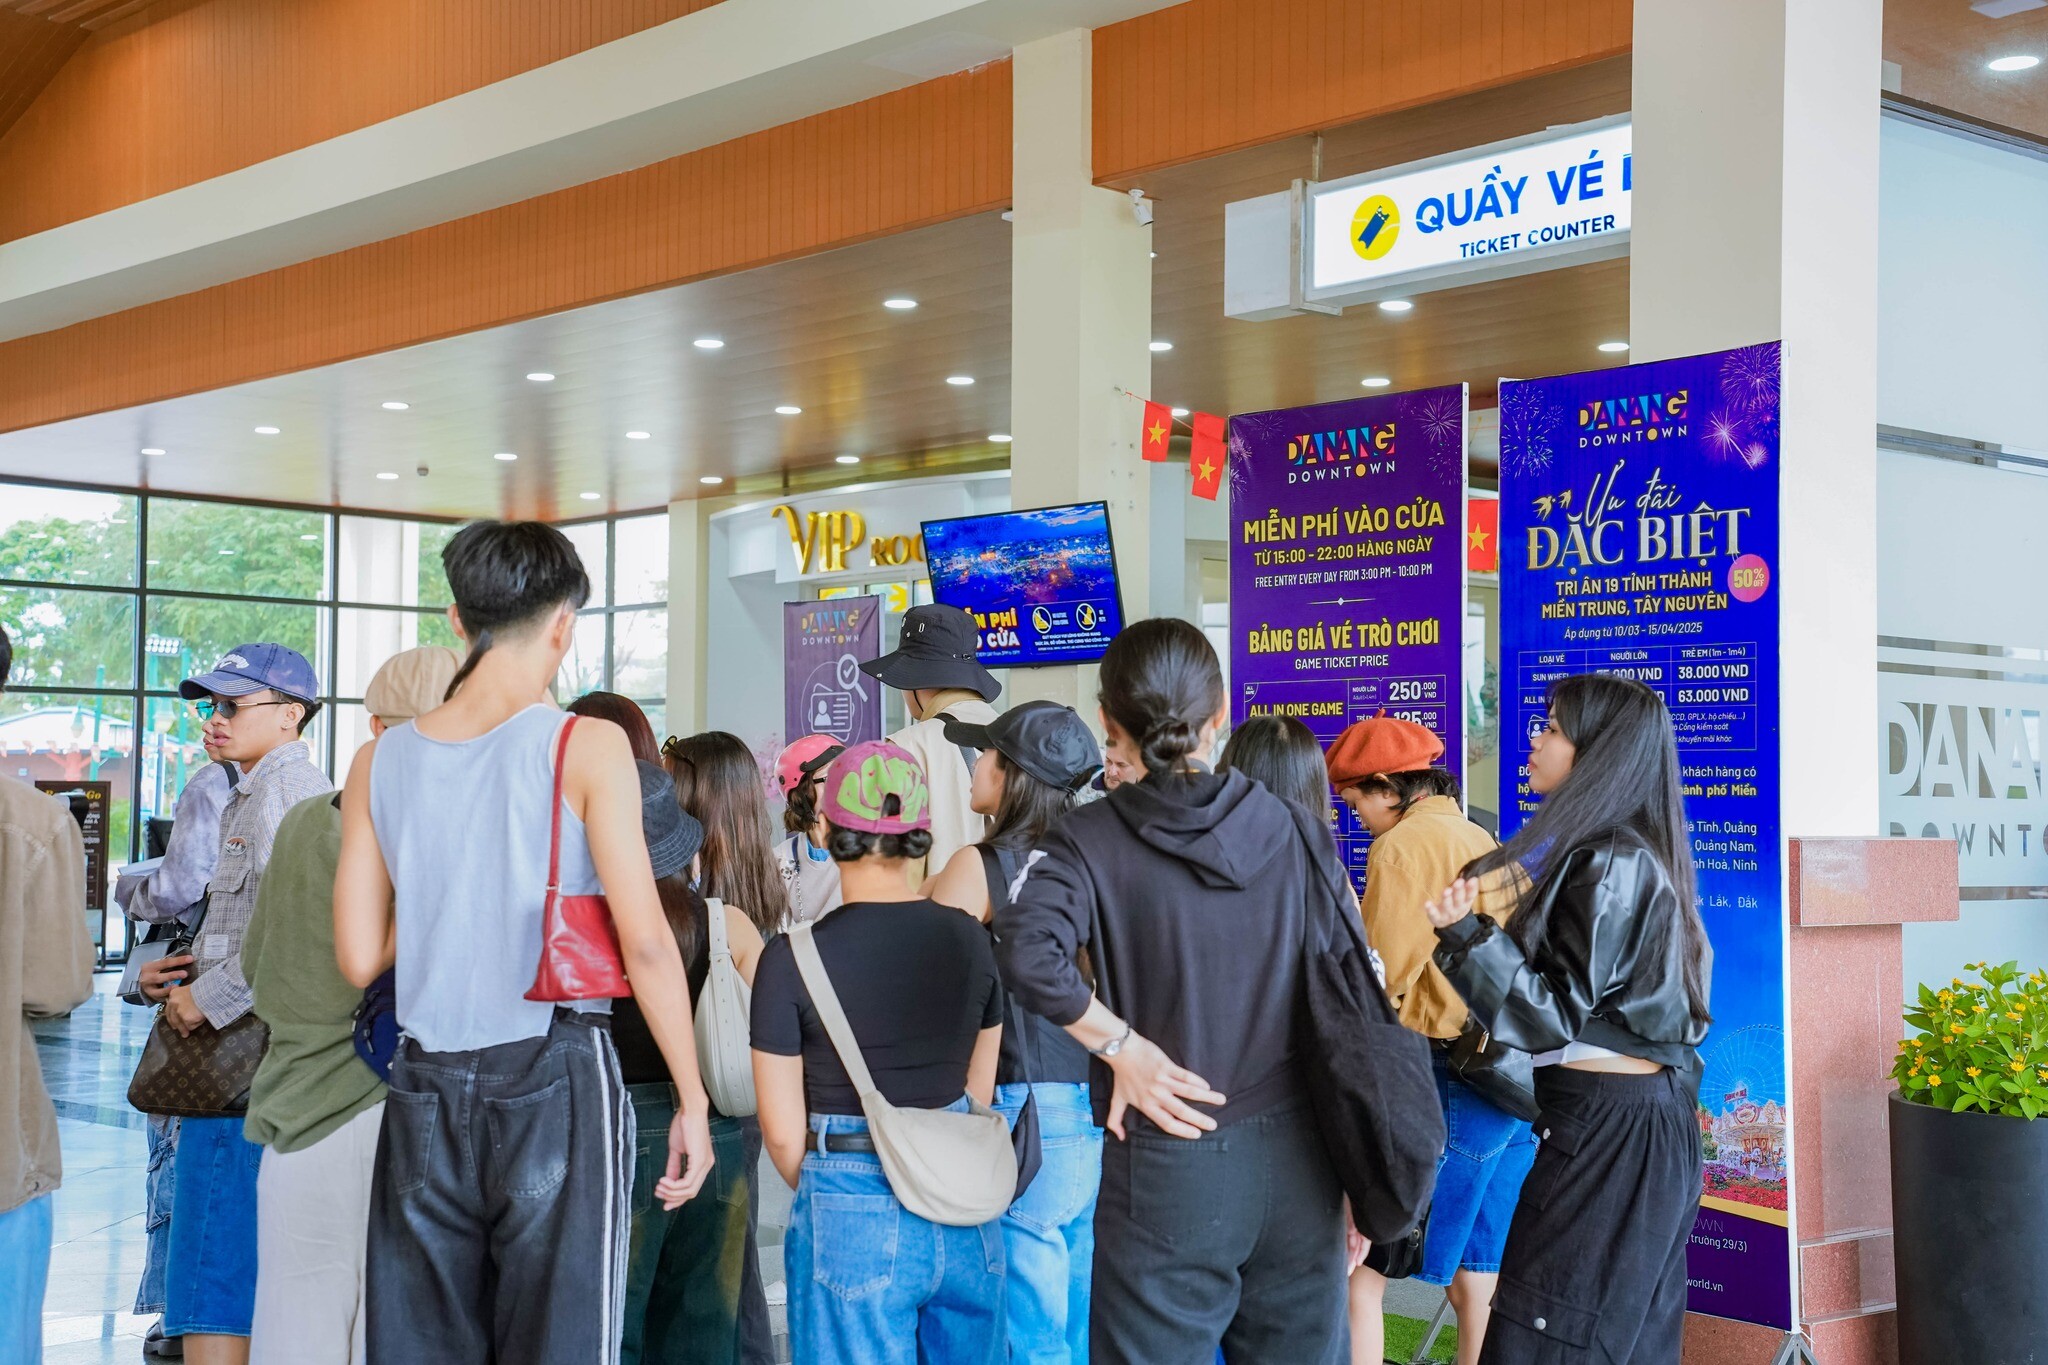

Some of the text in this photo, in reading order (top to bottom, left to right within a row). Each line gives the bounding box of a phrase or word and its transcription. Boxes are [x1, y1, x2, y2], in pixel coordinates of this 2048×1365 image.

[1416, 165, 1528, 234] QUẦY
[1547, 149, 1603, 206] VÉ
[1528, 214, 1615, 245] COUNTER
[1579, 390, 1688, 430] DANANG
[1288, 423, 1395, 466] DANANG
[1580, 425, 1687, 449] DOWNTOWN
[1288, 461, 1395, 484] DOWNTOWN
[1636, 467, 1681, 519] đãi
[1244, 496, 1445, 544] MIỄN PHÍ VÀO CỬA
[771, 504, 924, 575] VIP ROO
[1527, 501, 1751, 575] ĐẶC BIỆT
[1254, 548, 1271, 566] TỪ
[1273, 549, 1306, 564] 15:00
[1317, 544, 1354, 562] 22:00
[1356, 539, 1393, 558] HÀNG
[1397, 536, 1434, 554] NGÀY
[1255, 575, 1273, 588] FREE
[1274, 573, 1298, 587] ENTRY
[1299, 572, 1323, 585] EVERY
[1324, 571, 1338, 584] DAY
[1339, 569, 1360, 582] FROM
[1361, 568, 1378, 580] 3:00
[1380, 567, 1391, 579] PM
[1398, 565, 1419, 578] 10:00
[1421, 563, 1433, 575] PM
[1556, 569, 1712, 596] TRI ÂN 19 TỈNH THÀNH
[1541, 590, 1727, 619] MIỀN TRUNG, TÂY NGUYÊN
[989, 607, 1018, 628] PHÍ
[801, 633, 860, 646] DOWNTOWN
[987, 627, 1020, 648] CỬA
[1249, 617, 1439, 654] BẢNG GIÁ VÉ TRÒ CHƠI
[1564, 626, 1577, 640] Áp
[1578, 627, 1601, 640] dụng
[1602, 626, 1612, 637] từ
[1614, 624, 1640, 637] 10/03
[1648, 621, 1703, 635] 15/04/2025
[1539, 654, 1565, 665] LOẠI VÉ
[1610, 650, 1648, 661] NGƯỜI LỚN
[1682, 647, 1696, 658] TRẺ
[1697, 648, 1708, 657] EM
[1728, 646, 1746, 656] 1m4)
[1294, 654, 1389, 670] GAME TICKET PRICE
[1678, 664, 1748, 679] 38.000 VND
[1532, 673, 1547, 682] SUN
[1637, 668, 1662, 680] VND
[1678, 689, 1719, 703] 63.000
[1722, 688, 1748, 701] VND
[1249, 702, 1343, 717] ALL IN ONE GAME
[1679, 722, 1696, 732] Cổng
[1697, 722, 1712, 731] kiểm
[1887, 701, 2048, 799] DANA
[1682, 766, 1756, 779] khách hàng có
[1518, 784, 1530, 796] hộ
[1707, 783, 1727, 797] phố
[1731, 782, 1757, 796] Miền
[1518, 801, 1539, 811] Trun
[1696, 820, 1722, 833] Tĩnh,
[1723, 821, 1757, 836] Quảng
[1694, 839, 1757, 853] Quảng Nam,
[1707, 858, 1731, 870] Hoà,
[1733, 859, 1757, 871] Ninh
[1709, 893, 1732, 908] Lắk,
[1737, 895, 1758, 909] Đắk
[1691, 1234, 1748, 1253] trường 29/3)
